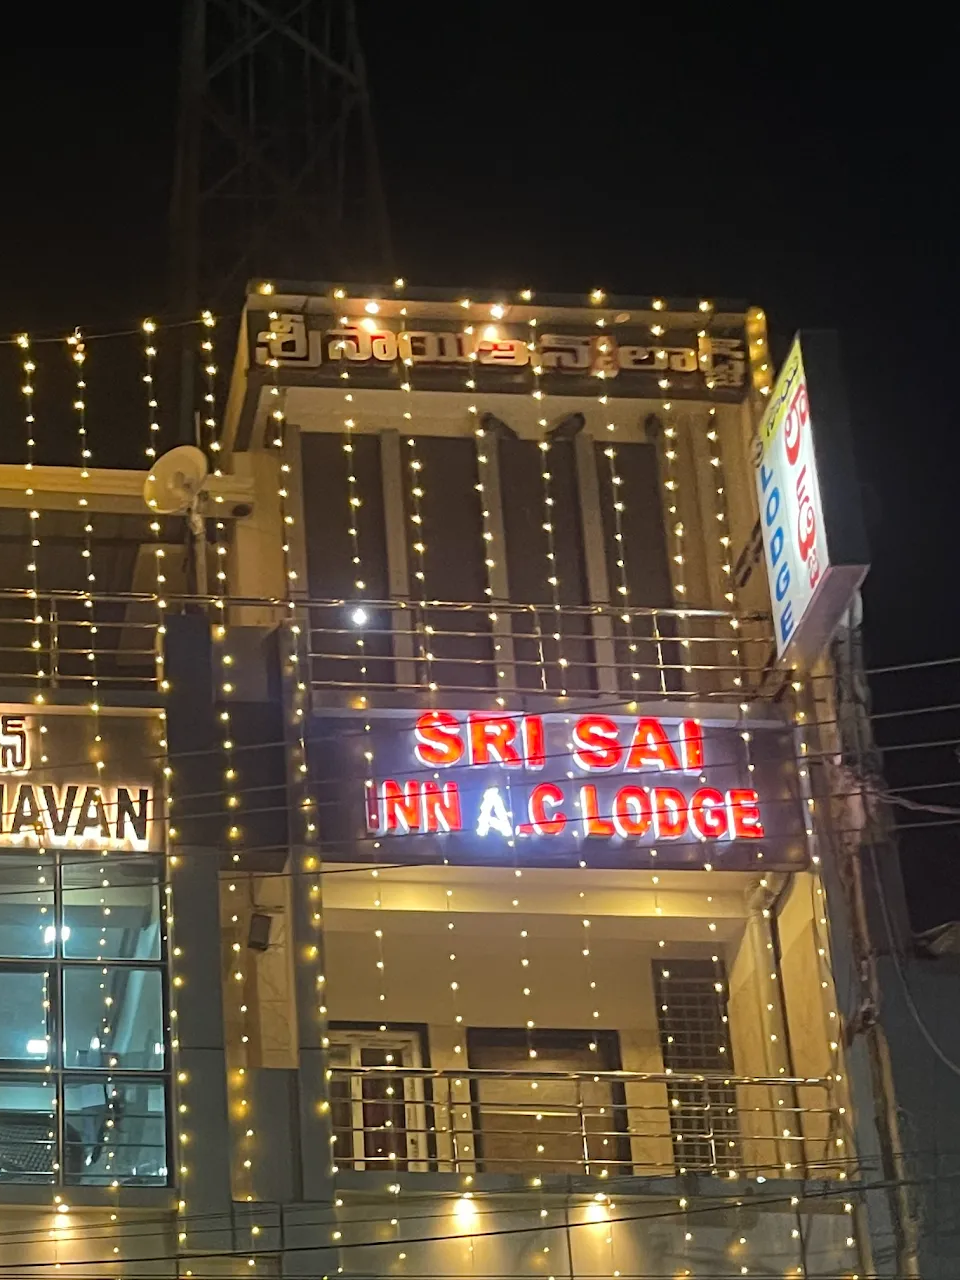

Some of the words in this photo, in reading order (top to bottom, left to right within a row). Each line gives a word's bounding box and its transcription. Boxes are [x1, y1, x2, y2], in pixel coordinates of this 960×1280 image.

[760, 466, 793, 643] LODGE
[414, 712, 544, 770] SRI
[572, 715, 703, 774] SAI
[366, 780, 462, 834] INN
[580, 784, 765, 840] LODGE
